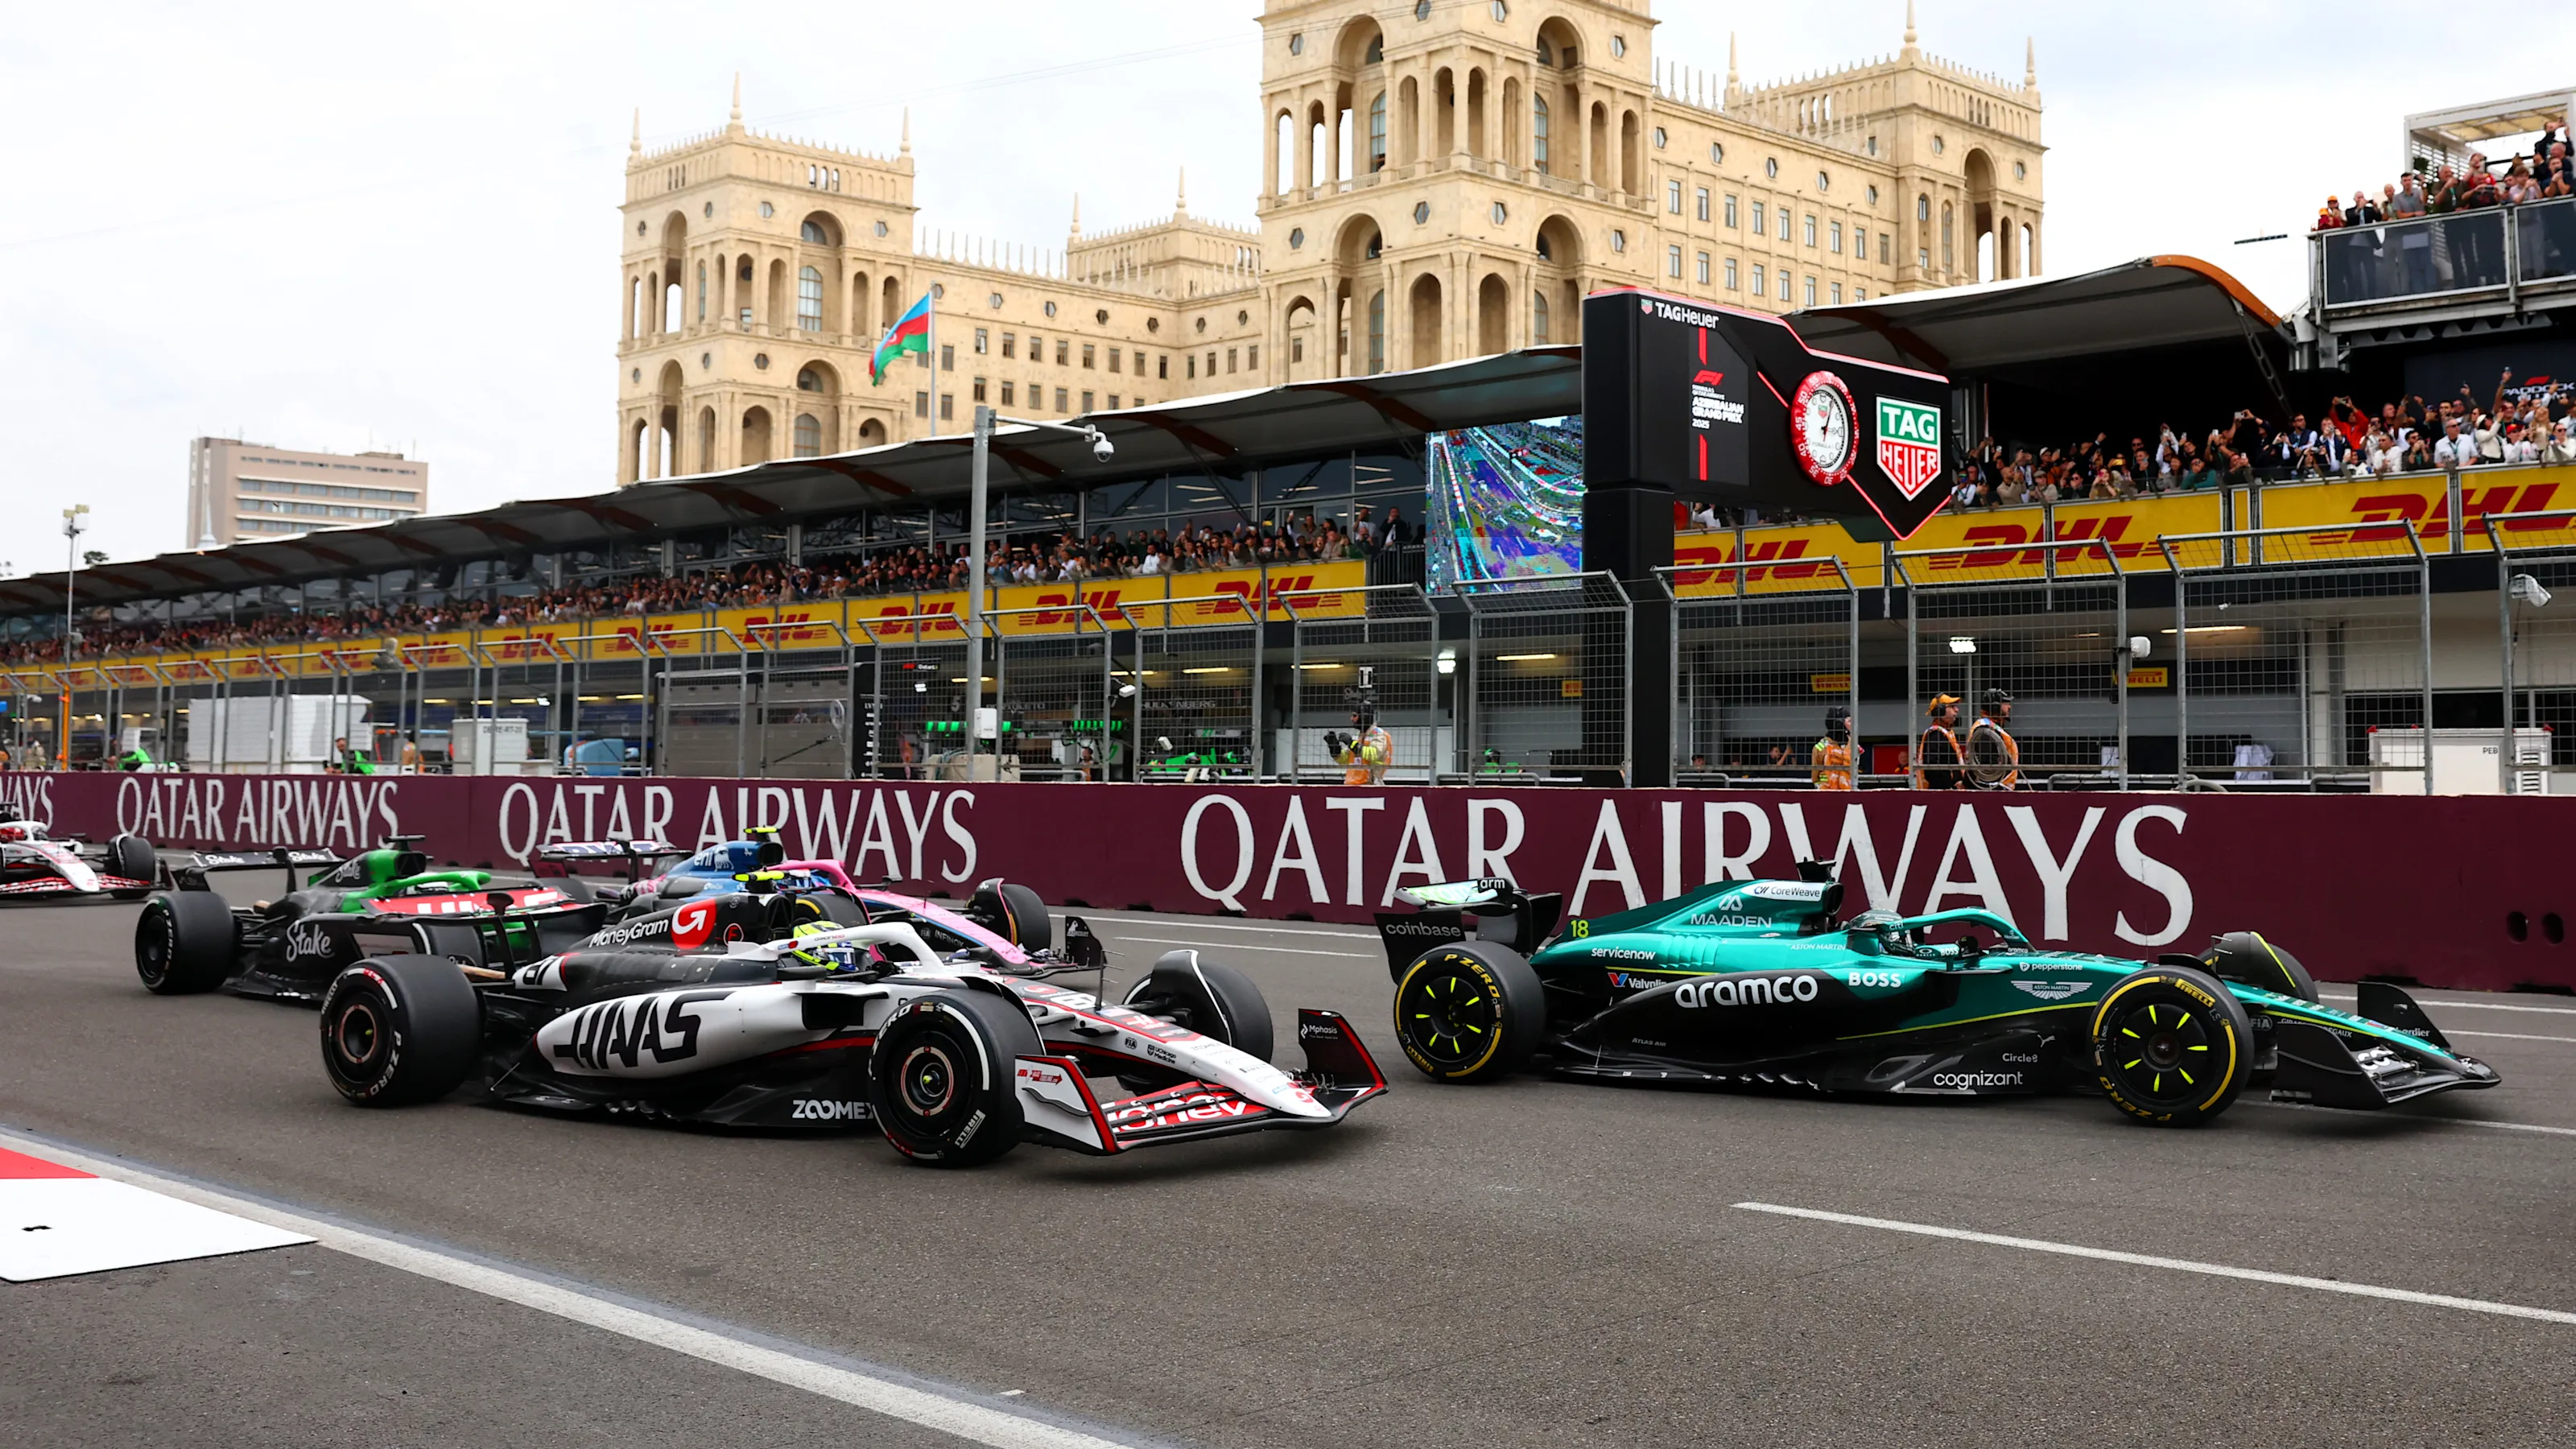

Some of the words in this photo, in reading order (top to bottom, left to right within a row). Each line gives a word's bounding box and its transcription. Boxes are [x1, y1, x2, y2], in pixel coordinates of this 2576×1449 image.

[1692, 419, 1711, 429] 2025
[1795, 416, 1803, 431] 45
[1881, 405, 1936, 442] TAG
[1880, 440, 1938, 493] HEUER
[2347, 481, 2560, 543] DHL
[1959, 515, 2142, 570] DHL
[1674, 539, 1821, 586] DHL
[1212, 576, 1321, 614] DHL
[1034, 589, 1125, 625] DHL
[742, 613, 815, 644] DHL
[877, 602, 960, 635] DHL
[502, 632, 561, 658] DHL
[615, 623, 678, 652] DHL
[2483, 746, 2499, 755] PEB
[117, 777, 225, 842] QATAR
[234, 779, 399, 852] AIRWAYS
[498, 781, 674, 868] QATAR
[694, 785, 977, 884] AIRWAYS
[205, 854, 246, 865] Stake
[288, 851, 327, 862] Stake
[694, 850, 714, 867] eni
[1180, 794, 1526, 912] QATAR
[1567, 798, 2194, 947] AIRWAYS
[1480, 878, 1505, 890] arm
[1770, 886, 1820, 898] CoreWeave
[1385, 921, 1462, 938] coinbase
[1571, 919, 1590, 939] 18
[1690, 913, 1772, 928] MAADEN
[1889, 920, 1905, 931] citi
[285, 919, 335, 963] Stake
[588, 918, 670, 948] MoneyGram
[1591, 946, 1657, 961] servicenow
[1815, 943, 1846, 952] MARTIN
[1940, 947, 1959, 956] BOSS
[1444, 953, 1458, 962] P
[1459, 956, 1501, 999] ZERO
[2031, 961, 2083, 972] pepperstone
[1628, 976, 1667, 989] Valvoli
[1847, 971, 1902, 989] BOSS
[1674, 974, 1818, 1009] aramco
[2174, 977, 2216, 1008] PIRELLI
[1309, 1025, 1338, 1035] Mphasis
[2250, 1019, 2270, 1029] FIA
[1632, 1037, 1654, 1046] ATLAS
[1154, 1053, 1176, 1064] Medicine
[1933, 1069, 2024, 1092] cognizant
[2099, 1075, 2153, 1119] ZERO
[1101, 1094, 1247, 1132] oney
[2157, 1113, 2173, 1121] P
[954, 1108, 987, 1150] PIRELLI
